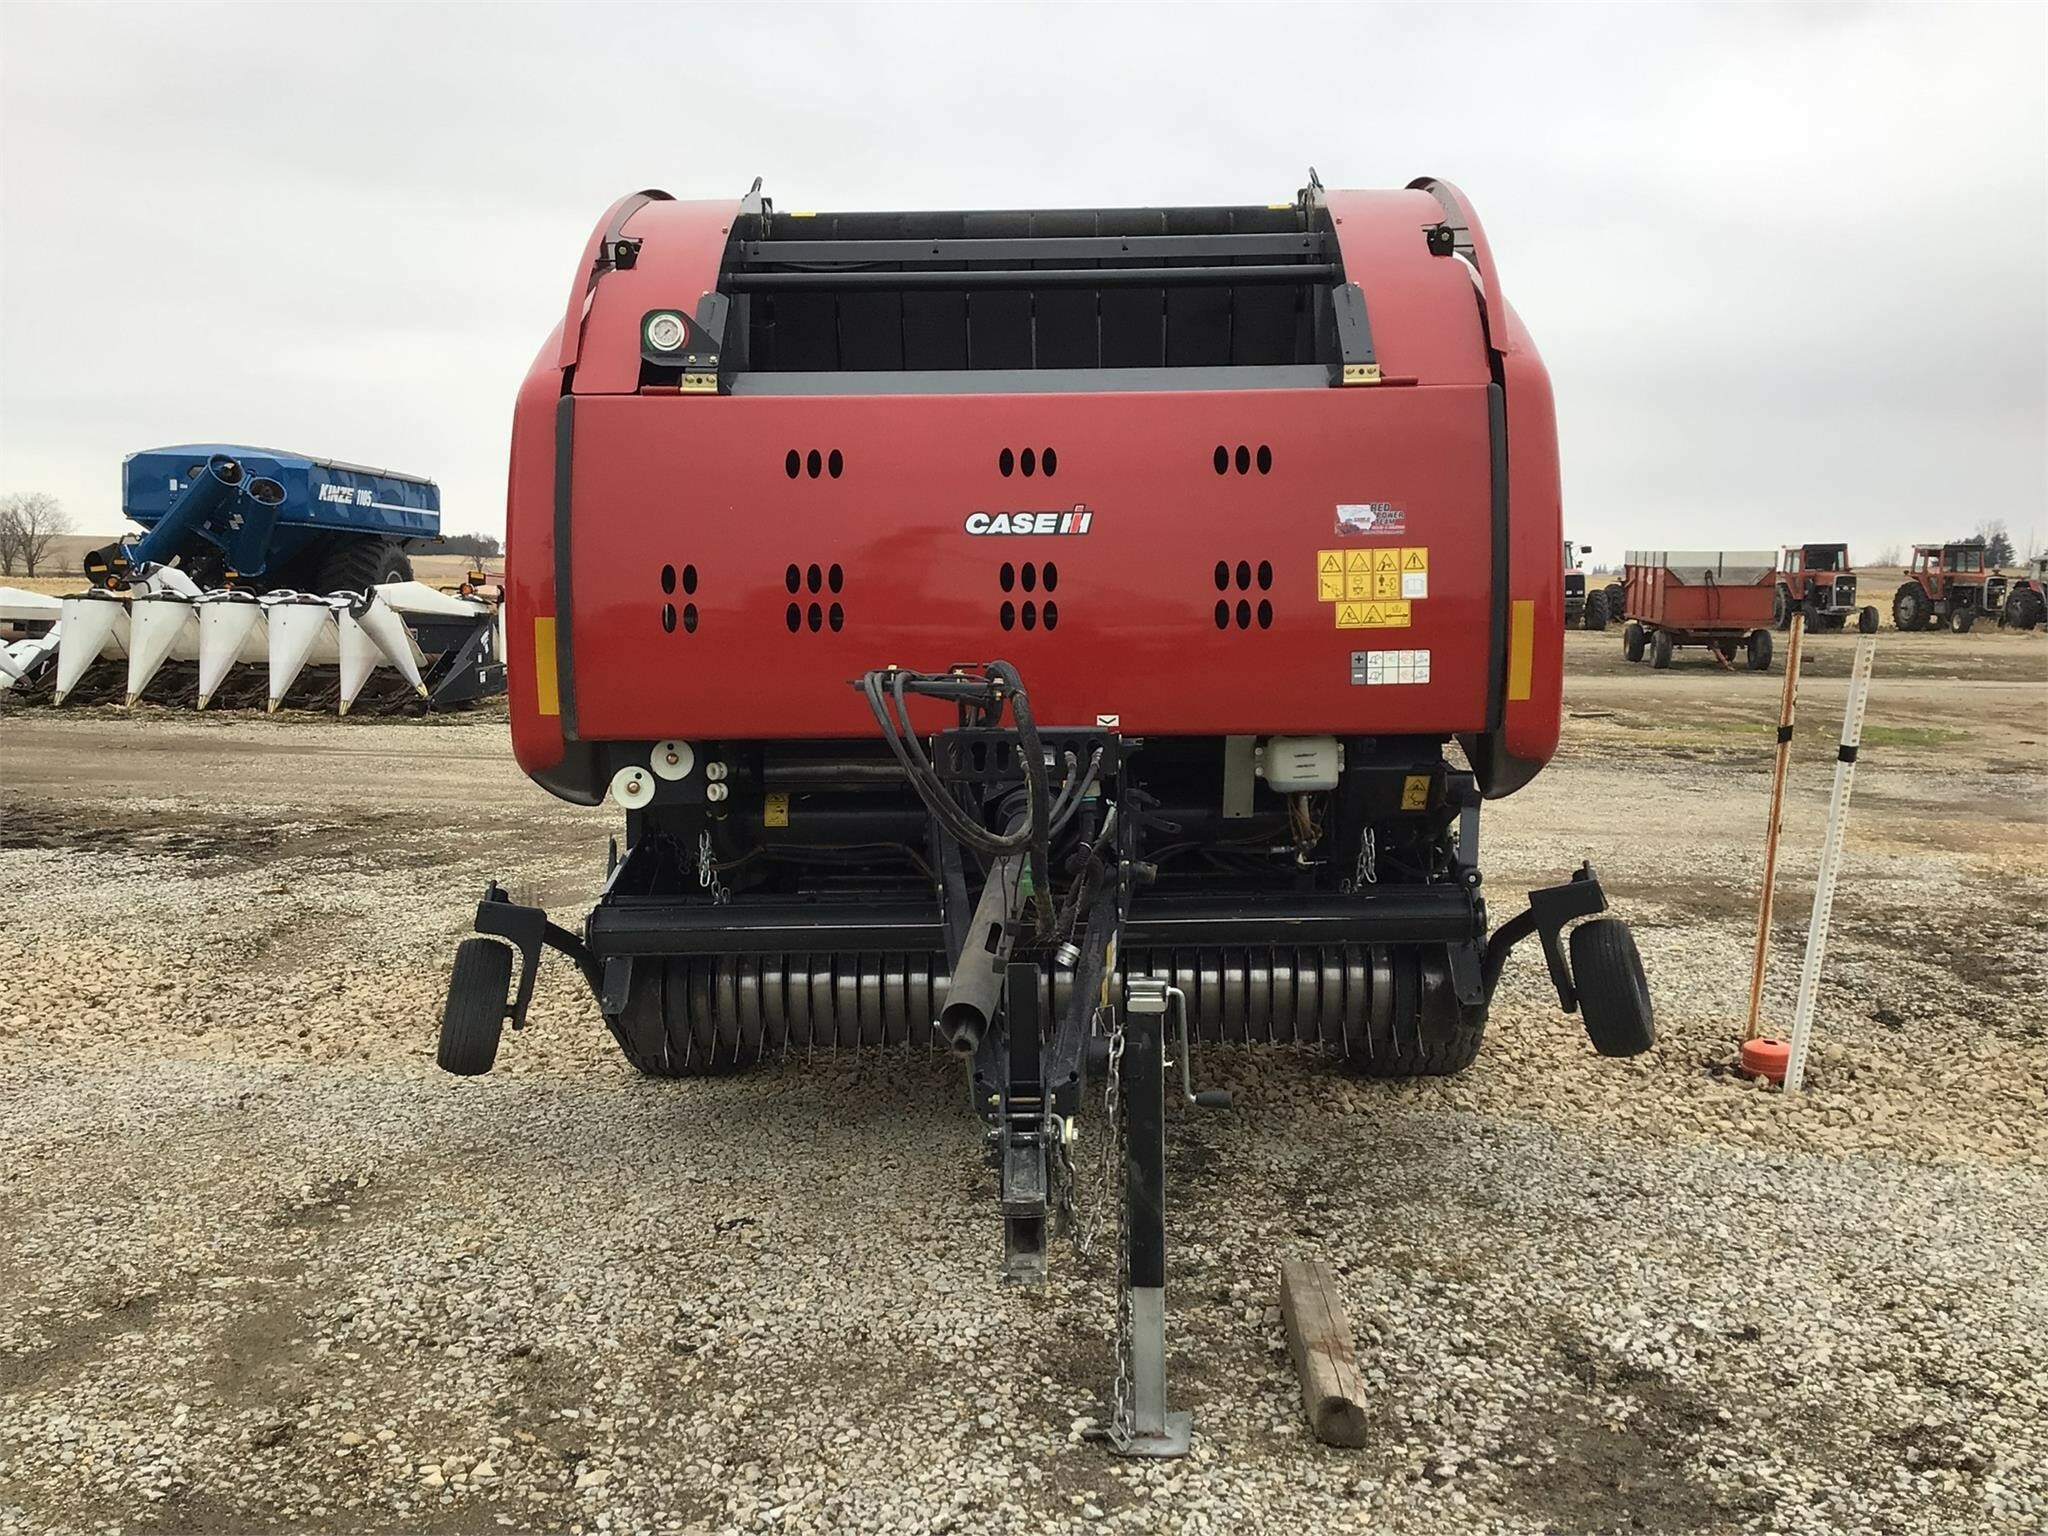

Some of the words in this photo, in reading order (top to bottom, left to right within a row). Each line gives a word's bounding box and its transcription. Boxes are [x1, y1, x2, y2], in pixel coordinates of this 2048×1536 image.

[318, 483, 354, 504] KINZE
[356, 489, 373, 507] 1105
[1370, 503, 1391, 512] RED
[1376, 511, 1404, 519] POWER
[965, 512, 1058, 535] CASE
